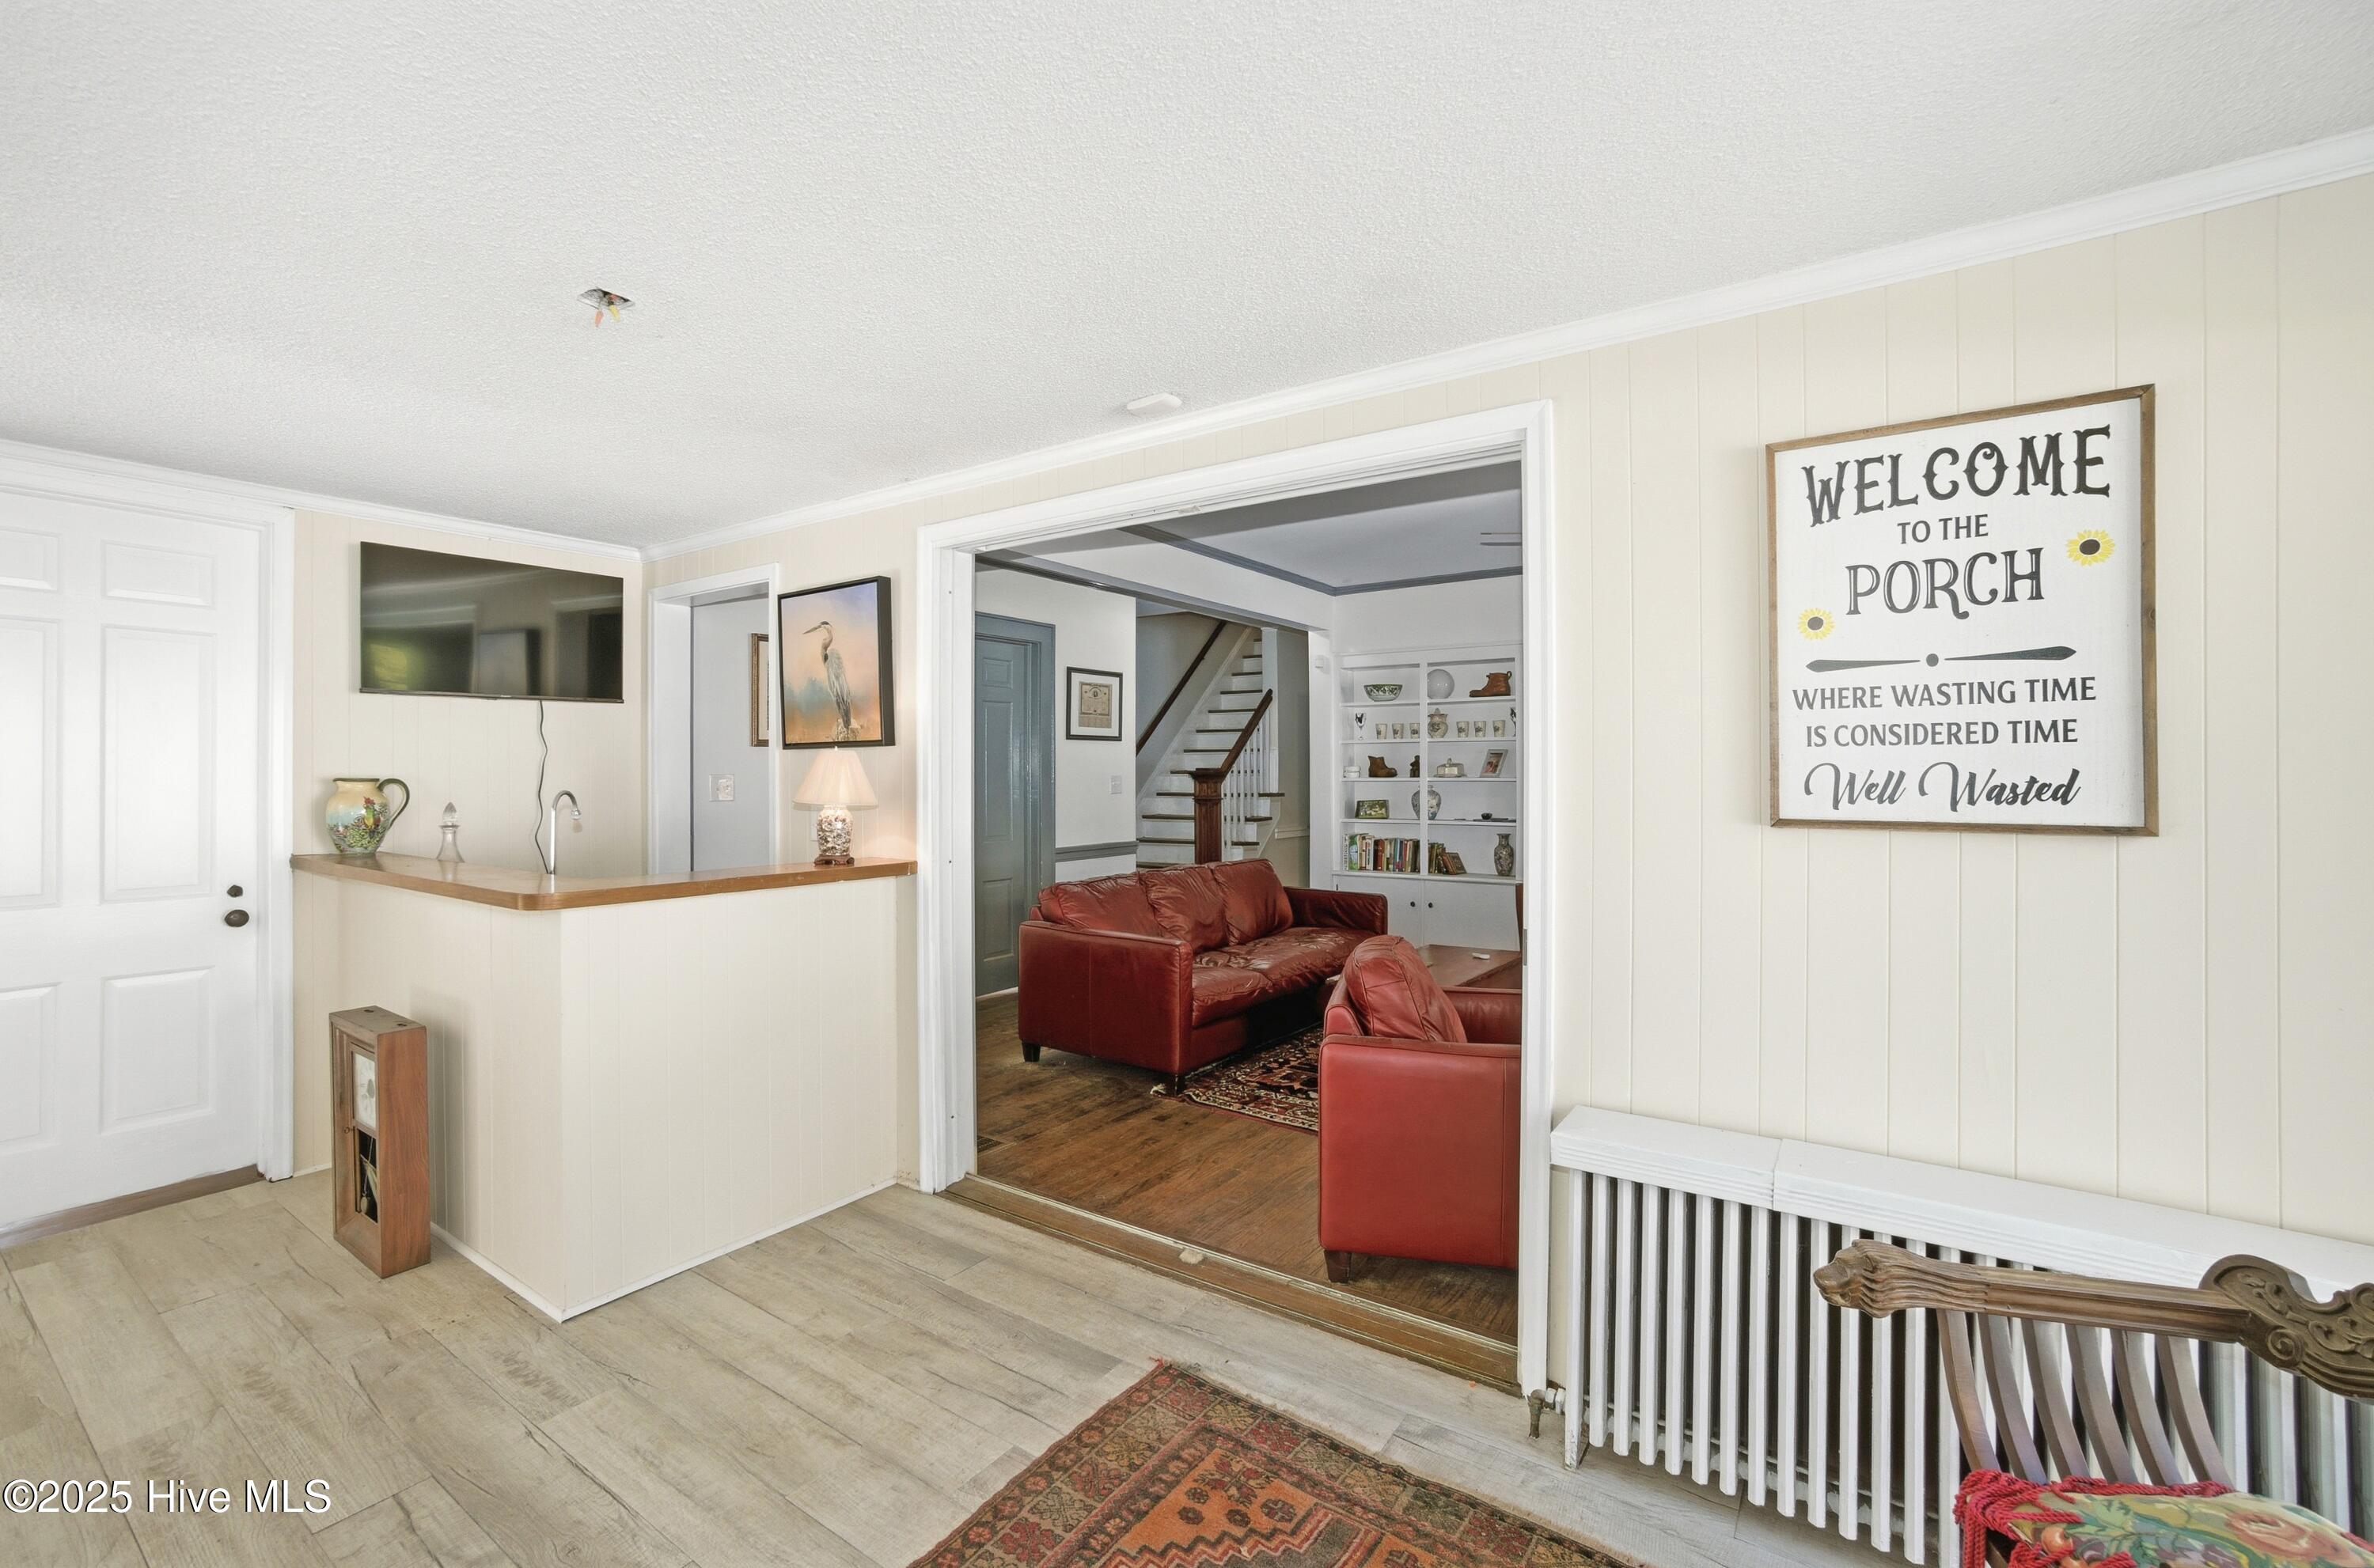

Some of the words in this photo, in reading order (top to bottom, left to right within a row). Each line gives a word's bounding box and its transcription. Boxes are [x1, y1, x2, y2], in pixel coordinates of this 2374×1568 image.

[1800, 424, 2110, 528] WELCOME
[1897, 520, 1931, 544] TO
[1938, 513, 1989, 540] THE
[1845, 547, 2045, 619] PORCH
[1792, 685, 1883, 710] WHERE
[1890, 680, 2016, 707] WASTING
[2024, 676, 2096, 703] TIME
[1806, 725, 1827, 748] IS
[1834, 721, 1999, 747] CONSIDERED
[2007, 718, 2078, 744] TIME
[1803, 763, 1906, 811] Well
[1918, 761, 2082, 812] Wasted
